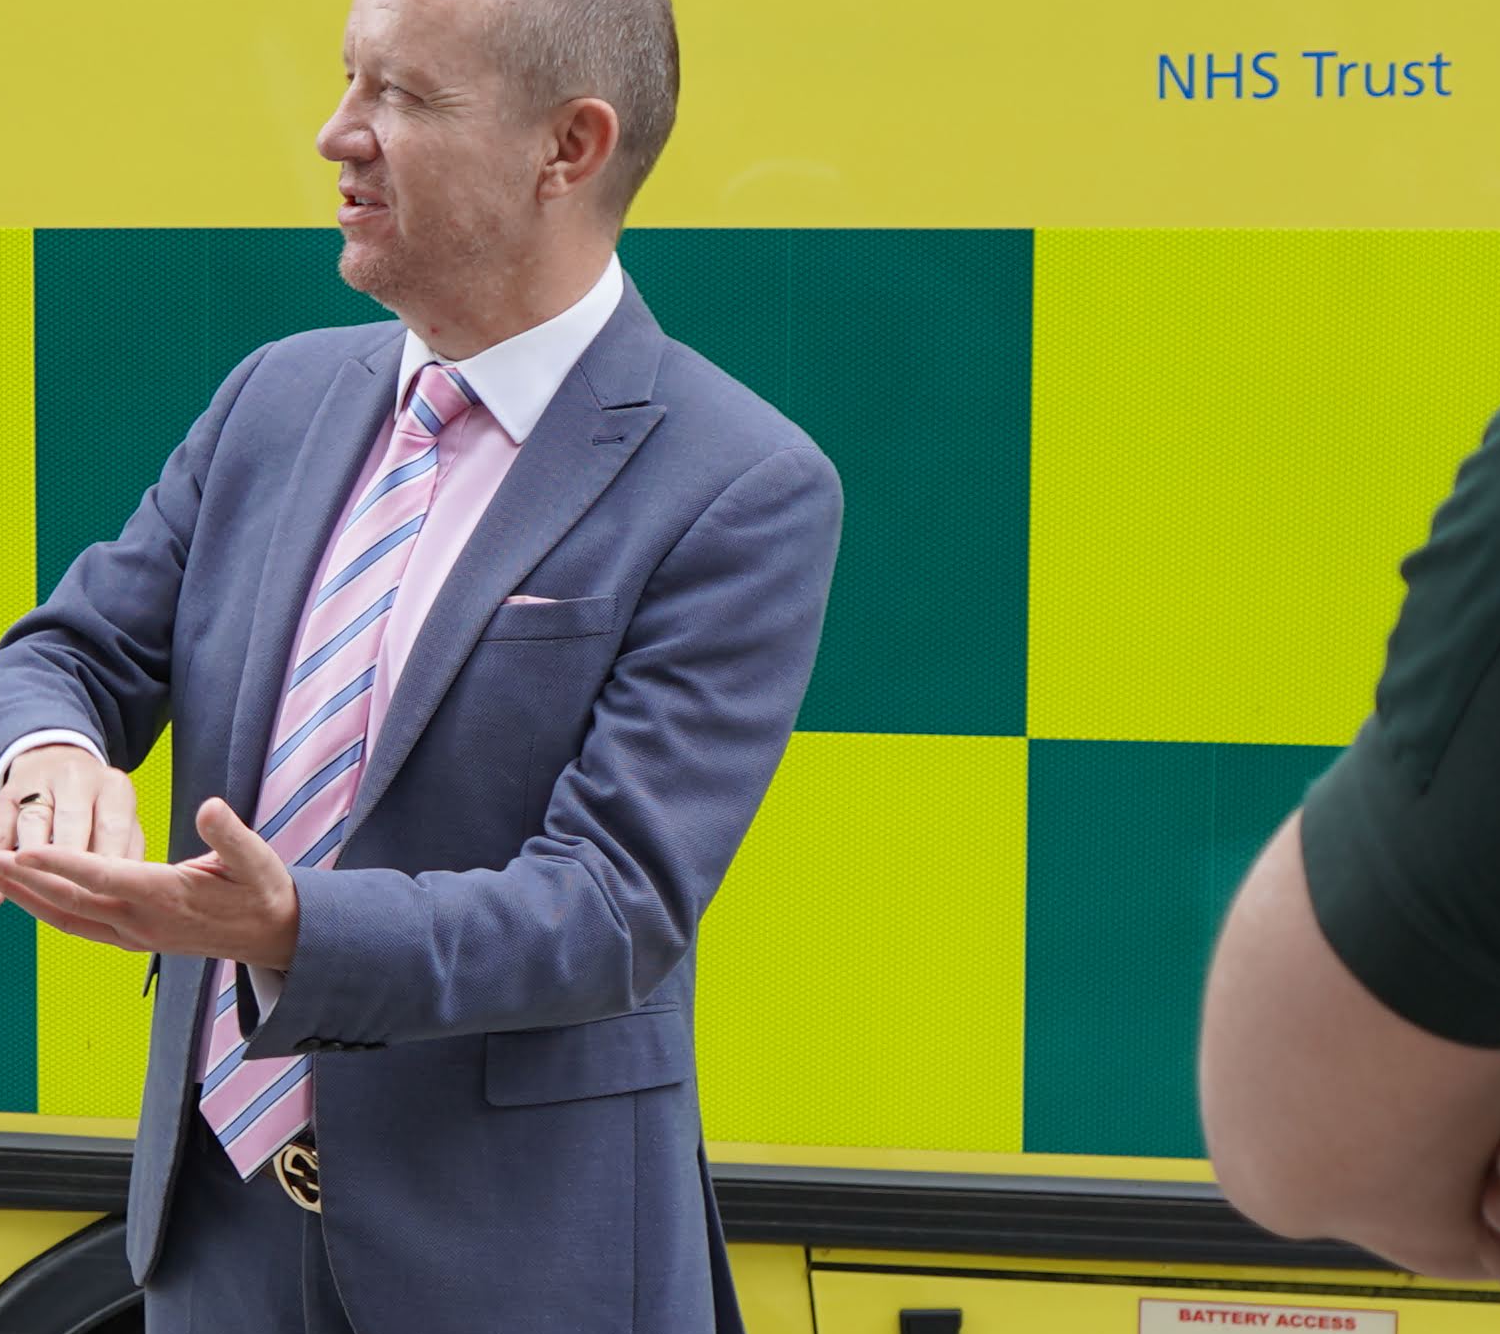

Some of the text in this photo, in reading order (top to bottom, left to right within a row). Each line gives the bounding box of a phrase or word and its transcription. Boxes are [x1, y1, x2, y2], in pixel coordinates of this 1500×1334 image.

[1157, 50, 1453, 101] NHS Trust
[1178, 1308, 1357, 1331] BATTERY ACCESS
